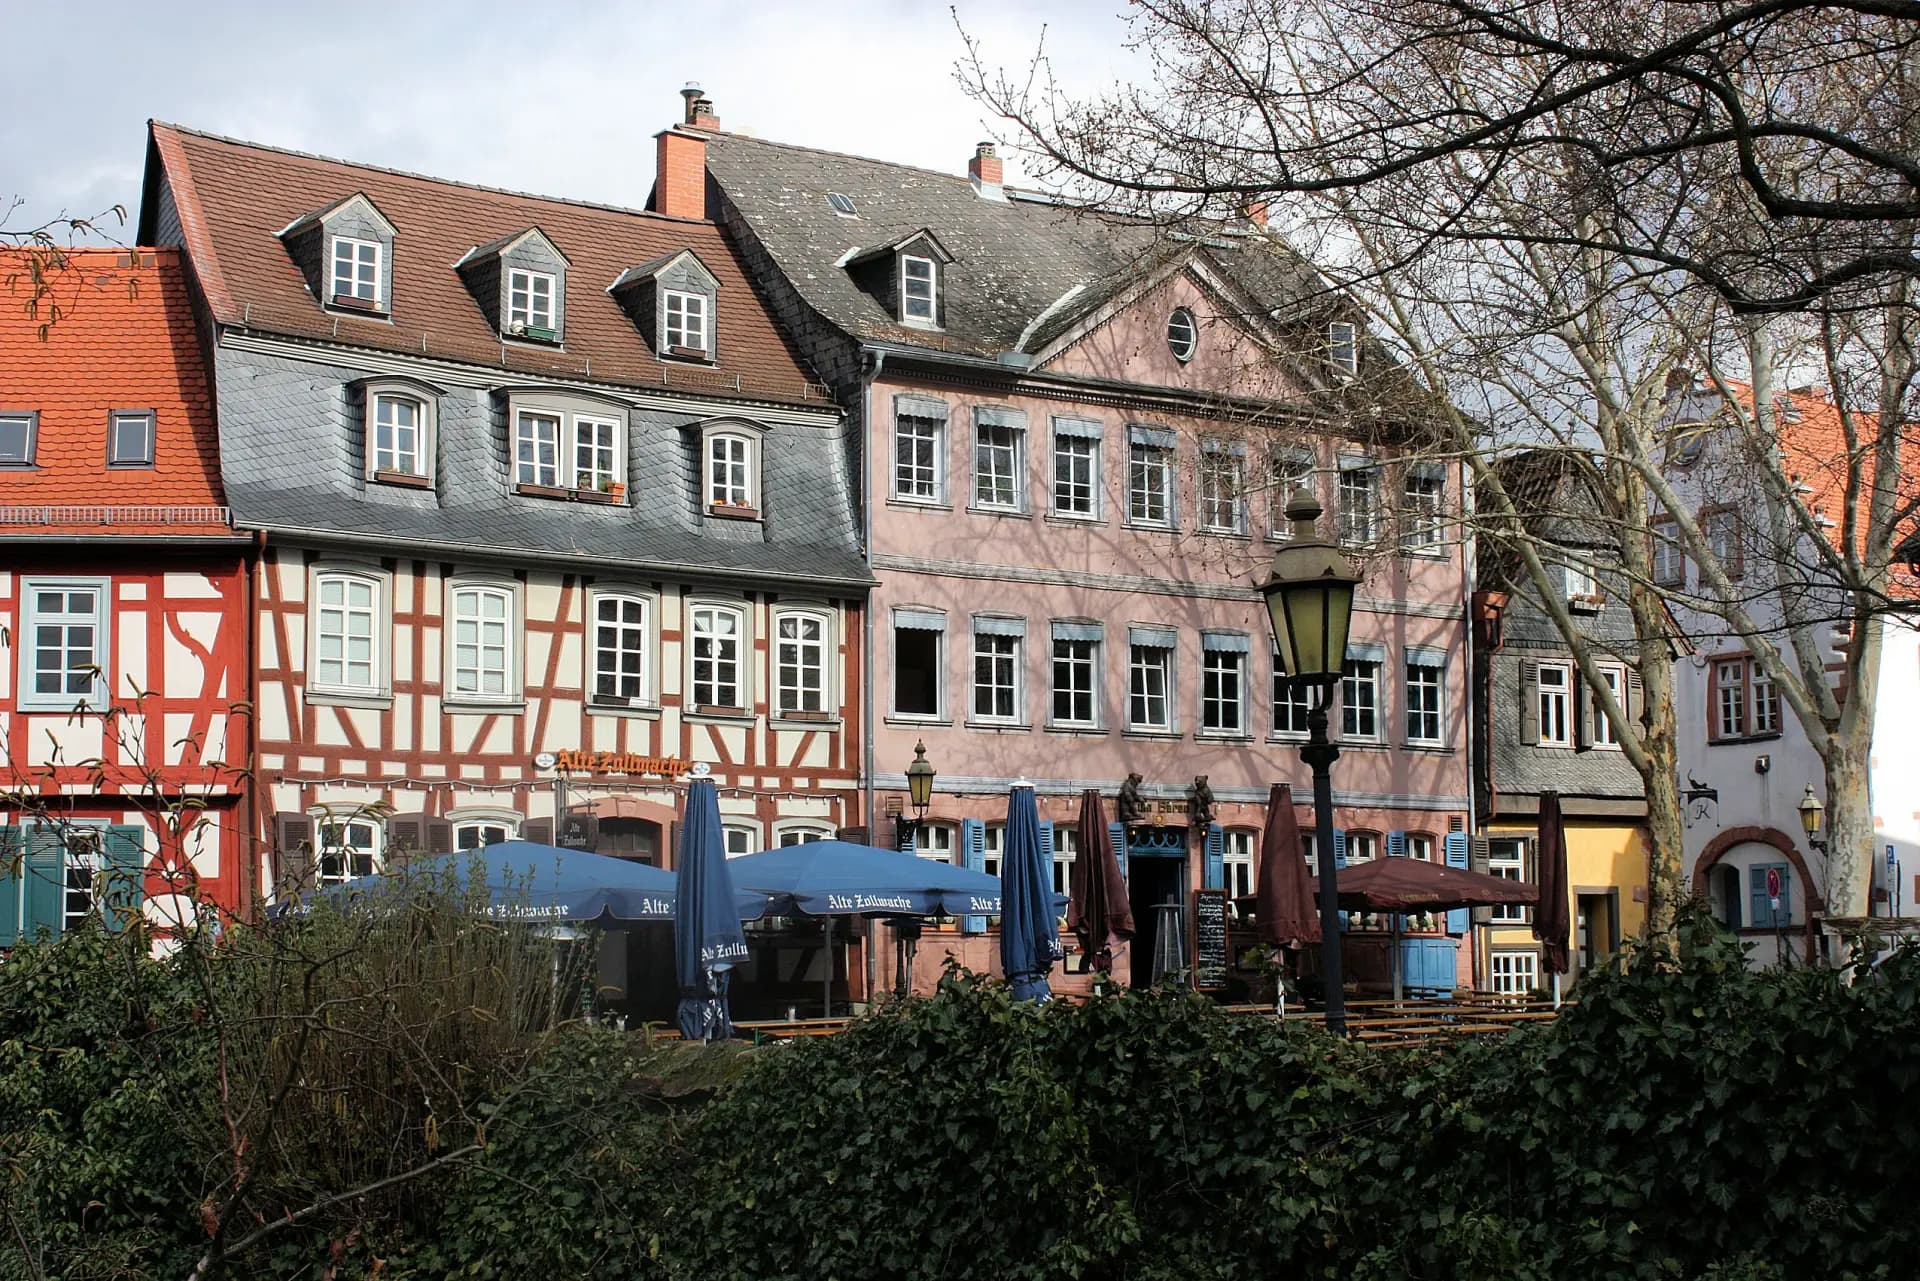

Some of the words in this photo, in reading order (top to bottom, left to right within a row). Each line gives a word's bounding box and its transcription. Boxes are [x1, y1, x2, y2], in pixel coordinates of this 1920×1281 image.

[557, 748, 596, 769] Alte
[599, 751, 689, 781] Zollwache
[641, 898, 670, 914] Alte
[829, 894, 852, 909] Alte
[854, 894, 912, 911] Zollwache
[971, 896, 992, 911] Alte
